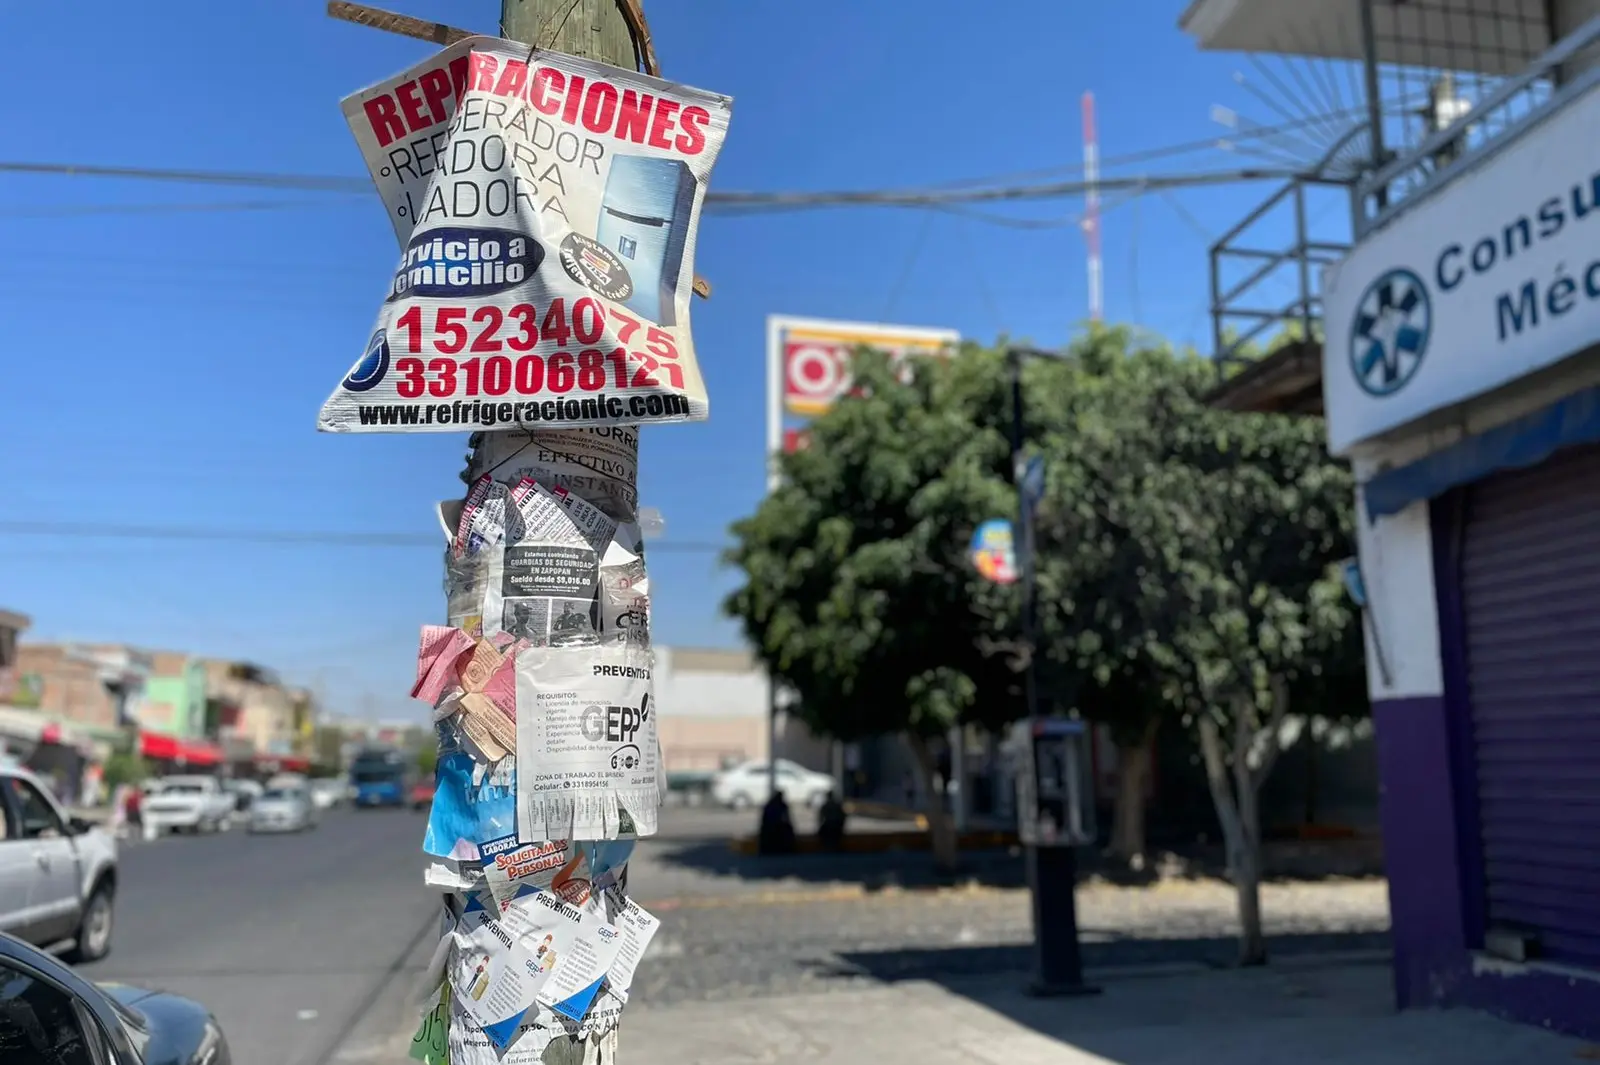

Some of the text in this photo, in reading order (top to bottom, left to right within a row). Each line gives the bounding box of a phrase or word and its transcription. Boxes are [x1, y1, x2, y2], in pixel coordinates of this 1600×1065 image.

[363, 52, 711, 154] REPARACIONES
[509, 238, 526, 257] a
[391, 261, 525, 295] omicilio
[396, 347, 684, 398] 3310068121
[539, 450, 624, 476] EFECTIVO
[541, 567, 571, 575] ZAPOPAN
[556, 560, 592, 569] SEGURIDAD
[484, 838, 518, 856] LABORAL
[495, 840, 568, 867] SOLICITAMOS
[507, 852, 566, 879] PERSONAL
[536, 893, 582, 923] PREVENTISTA
[479, 912, 514, 951] PREVENTISTA
